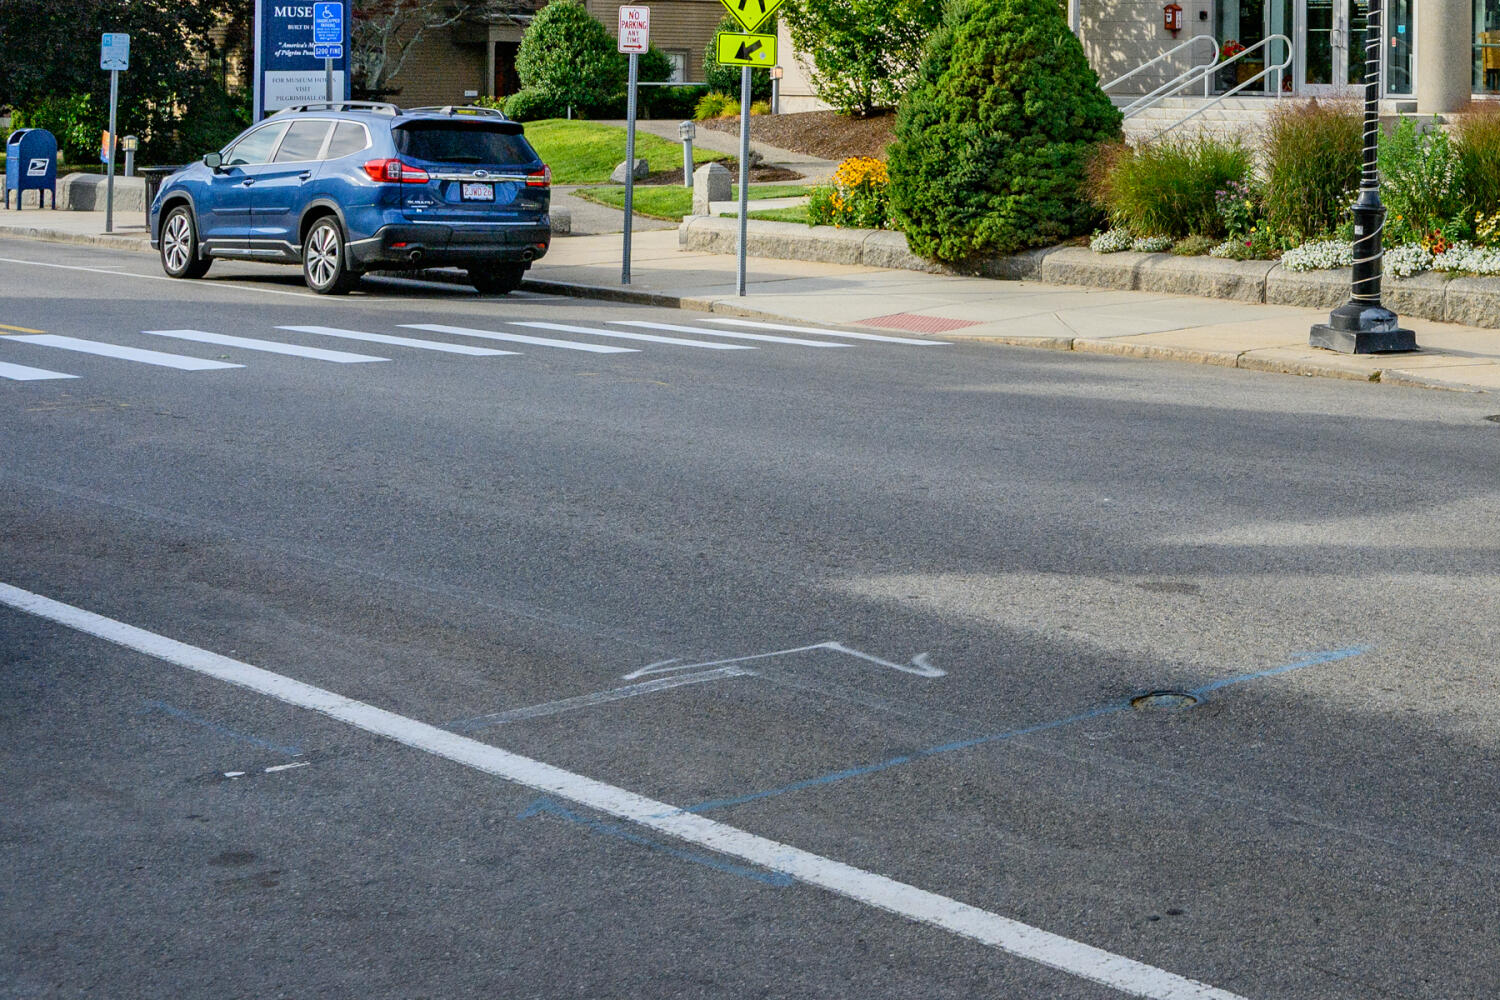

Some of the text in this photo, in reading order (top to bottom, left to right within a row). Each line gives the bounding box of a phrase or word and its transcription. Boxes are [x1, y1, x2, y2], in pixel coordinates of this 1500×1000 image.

[274, 6, 313, 18] MUSE
[628, 11, 640, 20] NO
[621, 20, 647, 30] PARKING
[274, 49, 281, 58] of
[281, 49, 302, 57] Pilgrim
[329, 47, 341, 55] FINE
